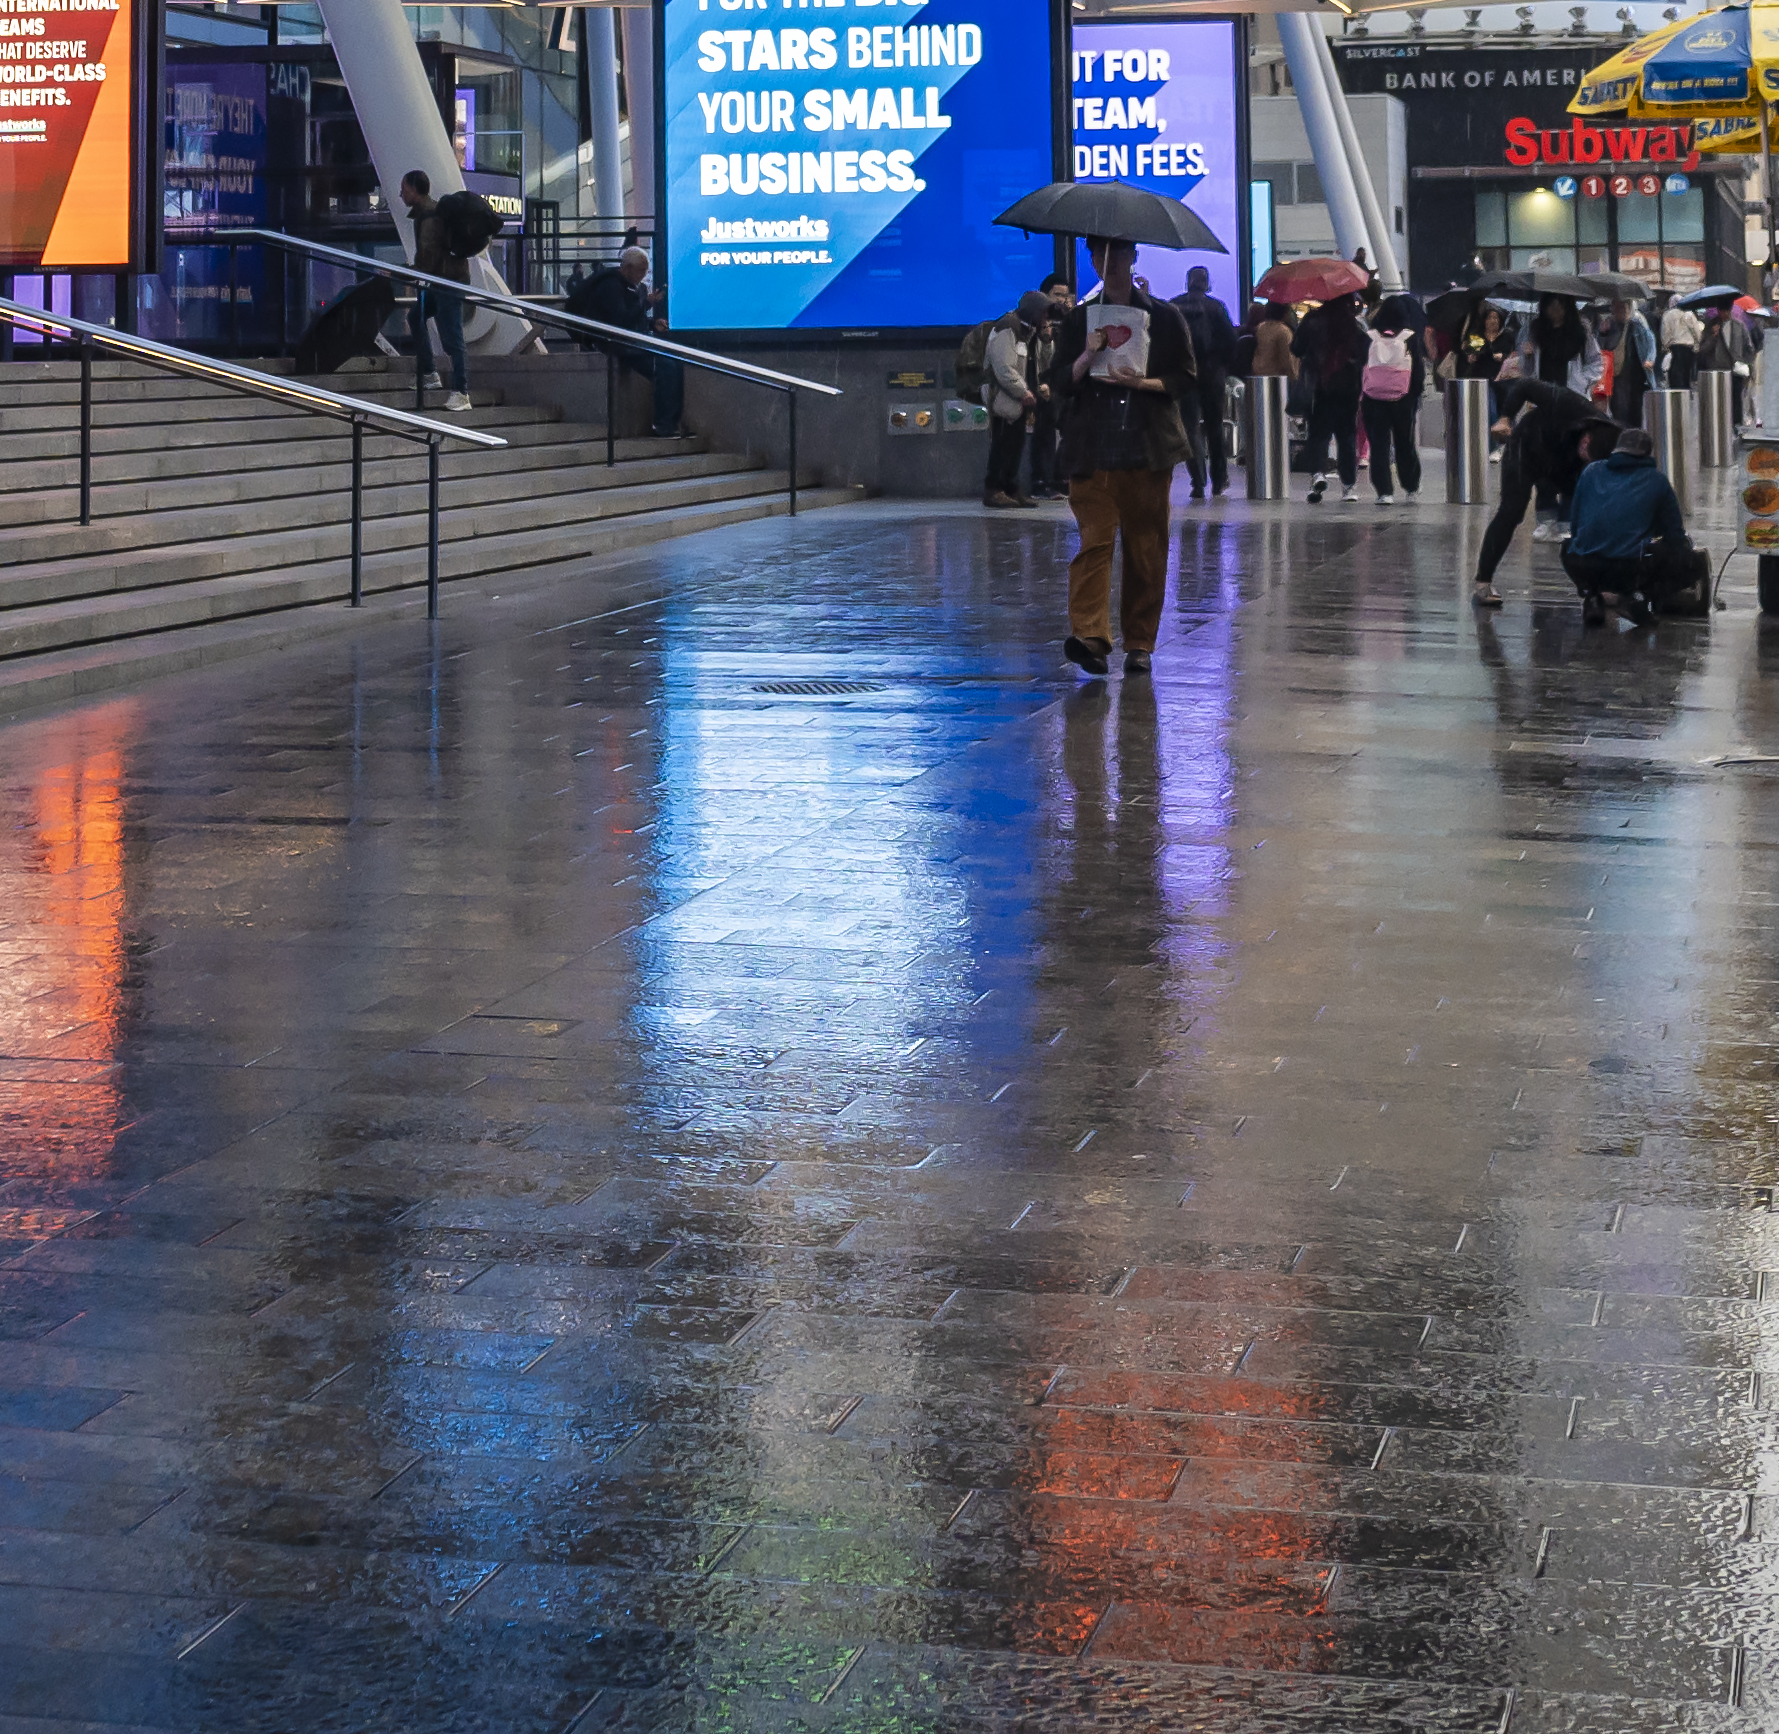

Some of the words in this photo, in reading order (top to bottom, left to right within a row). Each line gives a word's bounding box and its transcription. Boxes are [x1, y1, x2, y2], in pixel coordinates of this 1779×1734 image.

[26, 40, 87, 59] DESERVE
[697, 28, 838, 73] STARS
[848, 23, 982, 68] BEHIND
[1104, 49, 1171, 82] FOR
[1386, 73, 1455, 89] BANK
[1464, 71, 1496, 87] OF
[698, 90, 795, 134] YOUR
[803, 86, 952, 132] SMALL
[1136, 142, 1210, 177] FEES.
[1505, 117, 1700, 172] Subway
[700, 149, 926, 196] BUSINESS.
[1588, 179, 1598, 195] 1
[1615, 177, 1627, 194] 2
[1643, 176, 1655, 194] 3
[701, 215, 830, 240] Justworks
[701, 251, 730, 266] FOR
[731, 251, 772, 266] YOUR
[773, 250, 833, 265] PEOPLE.
